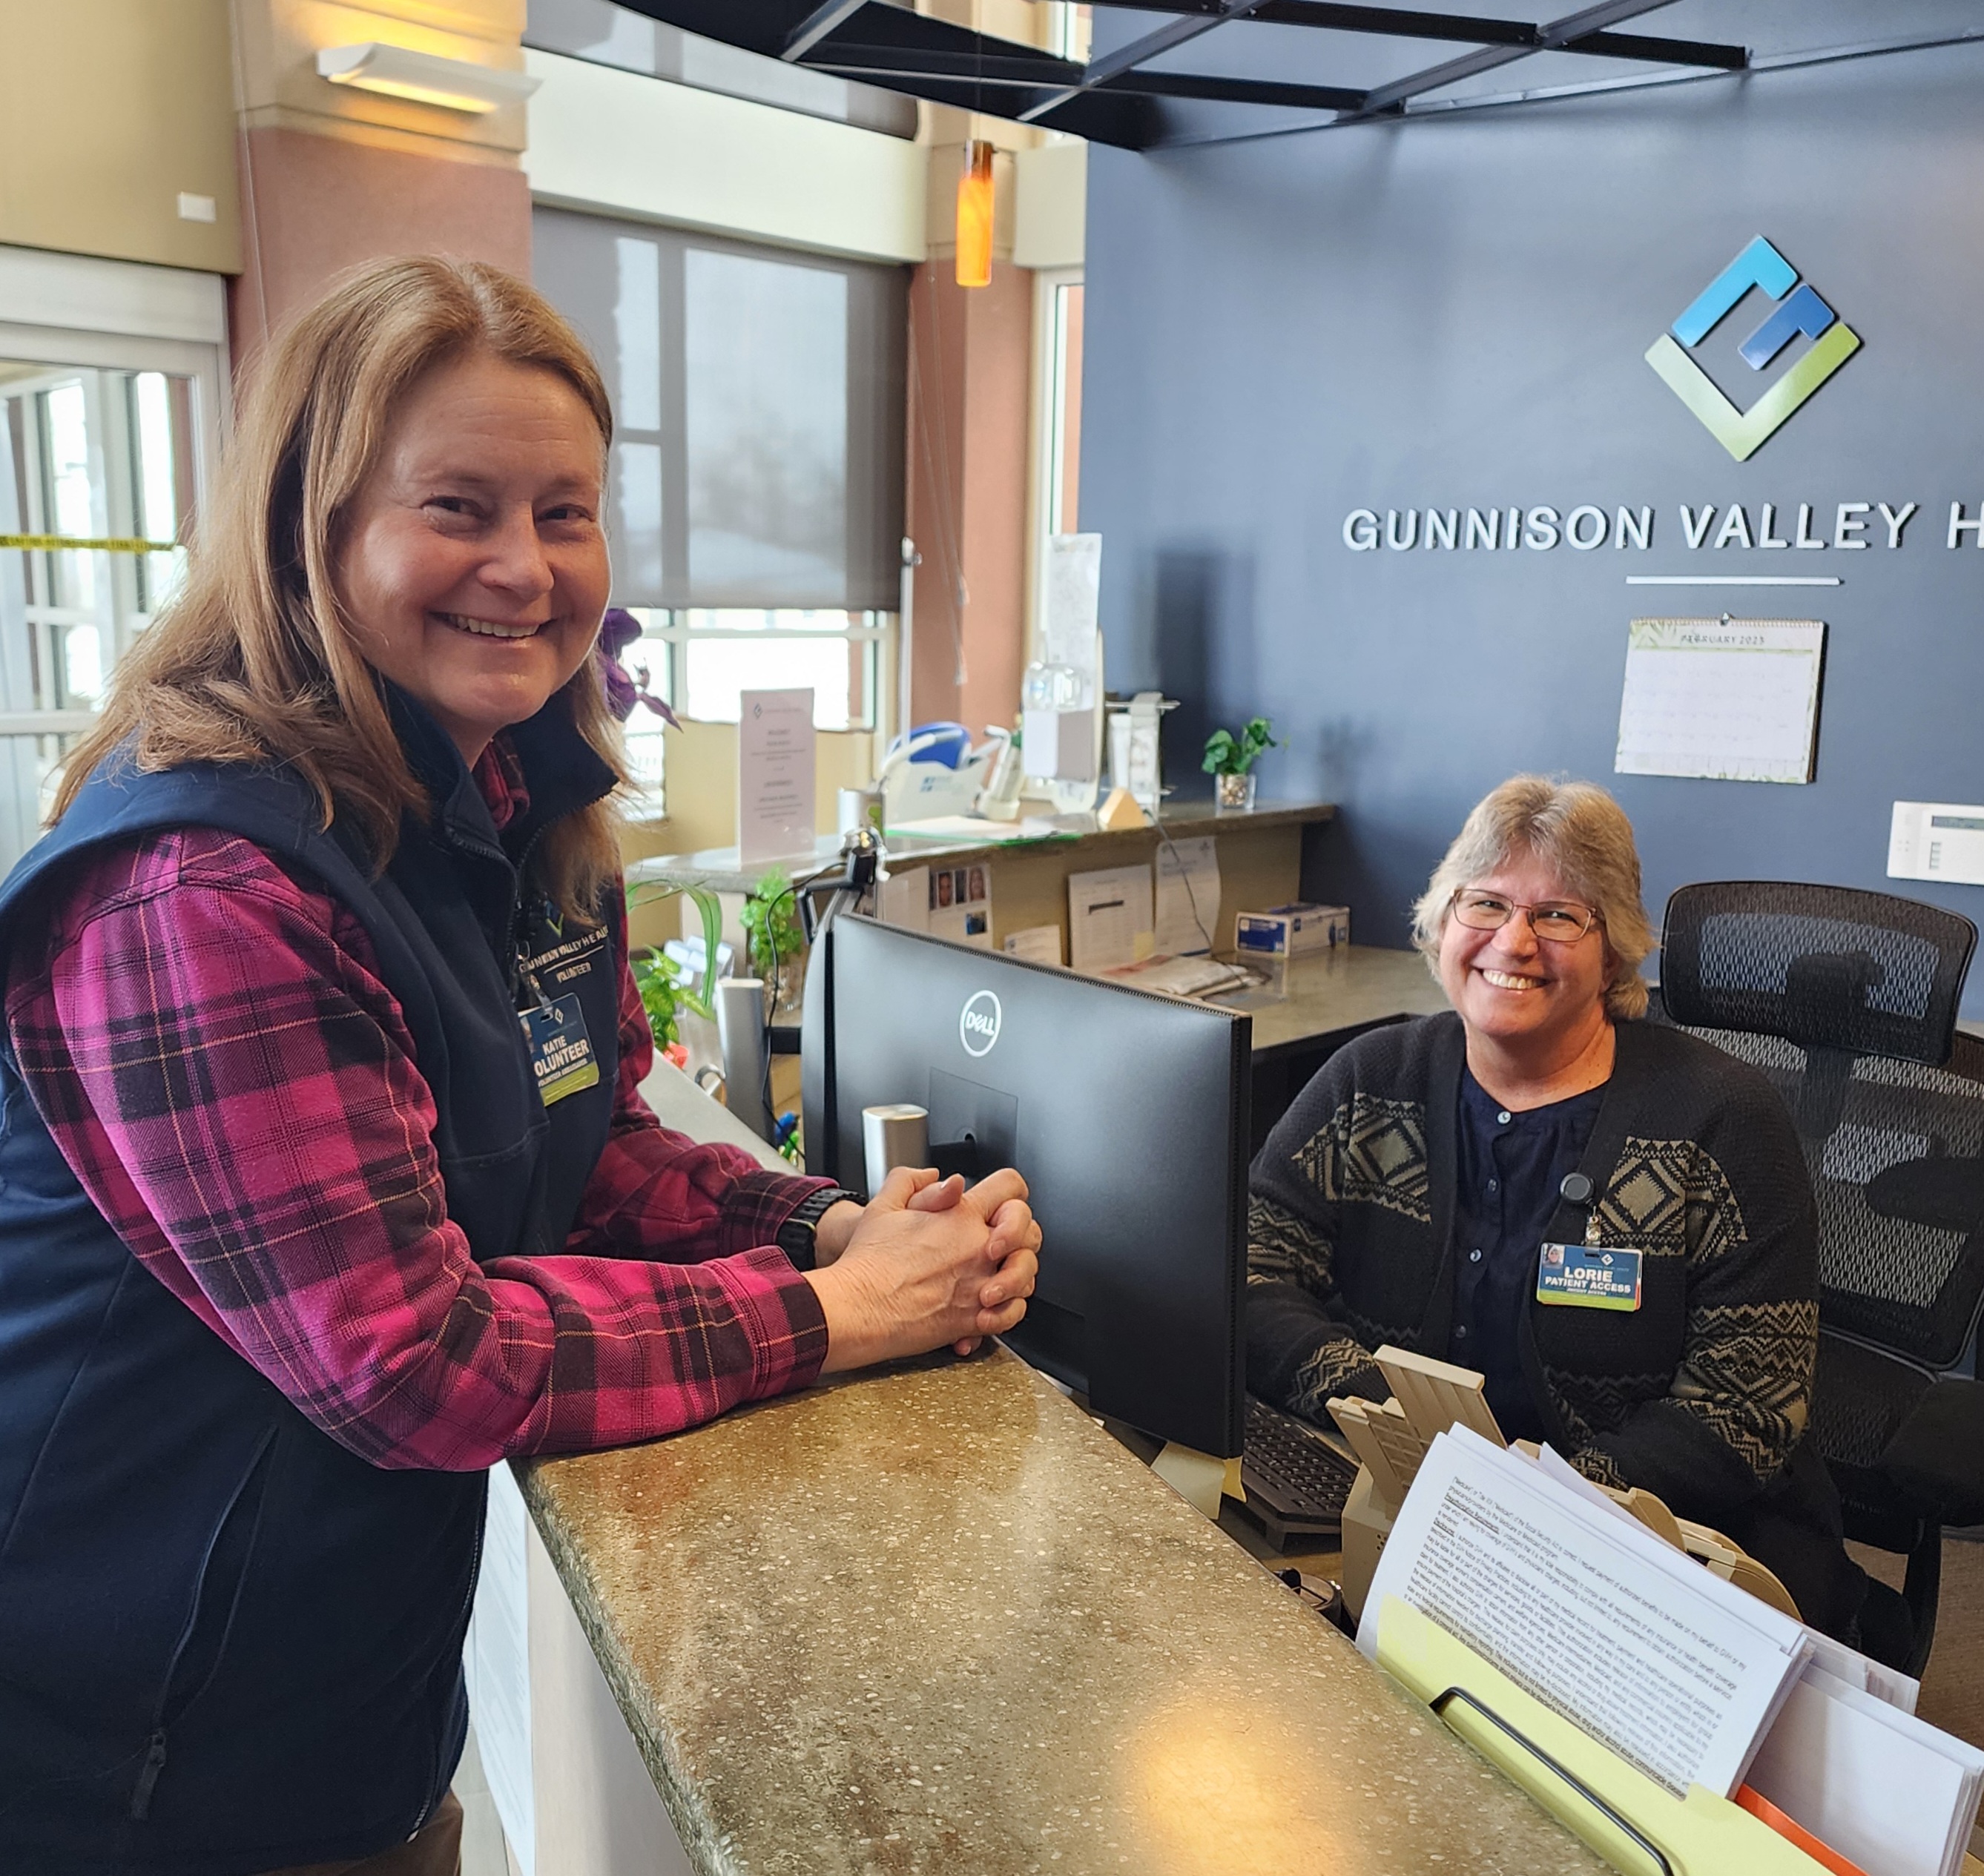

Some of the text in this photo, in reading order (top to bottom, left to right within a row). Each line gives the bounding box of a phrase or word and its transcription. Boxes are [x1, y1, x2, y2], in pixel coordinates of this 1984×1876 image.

[1342, 505, 1653, 551] GUNNISON
[1679, 502, 1919, 549] VALLEY
[965, 1011, 995, 1036] DELL
[542, 1035, 567, 1056] KATIE
[534, 1039, 590, 1077] OLUNTEER
[1545, 1276, 1631, 1293] PATIENT ACCESS
[1564, 1266, 1613, 1282] LORIE
